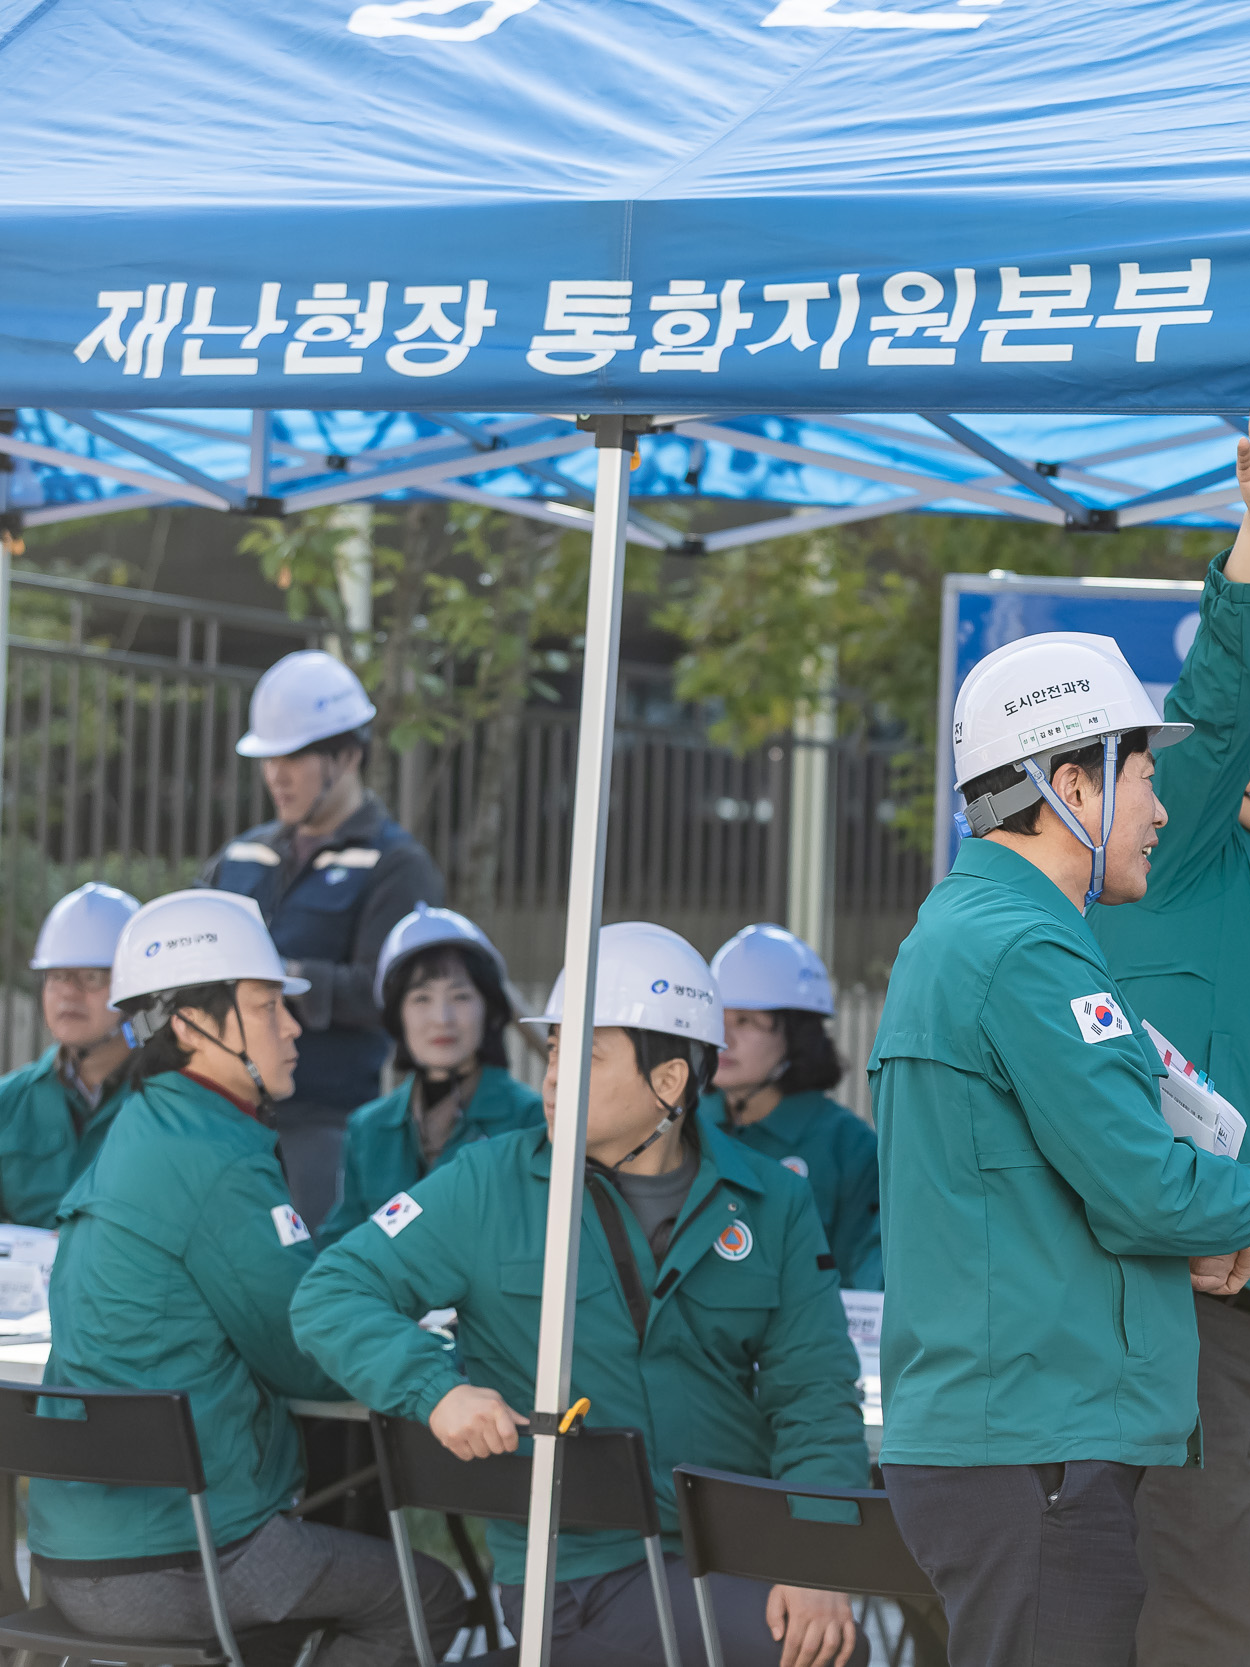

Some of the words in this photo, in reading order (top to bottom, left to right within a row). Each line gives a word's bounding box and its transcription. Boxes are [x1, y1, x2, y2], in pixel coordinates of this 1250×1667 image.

[74, 281, 497, 379] 재난현장
[526, 258, 1214, 377] 통합지원본부
[1004, 679, 1091, 716] 도시안전과장
